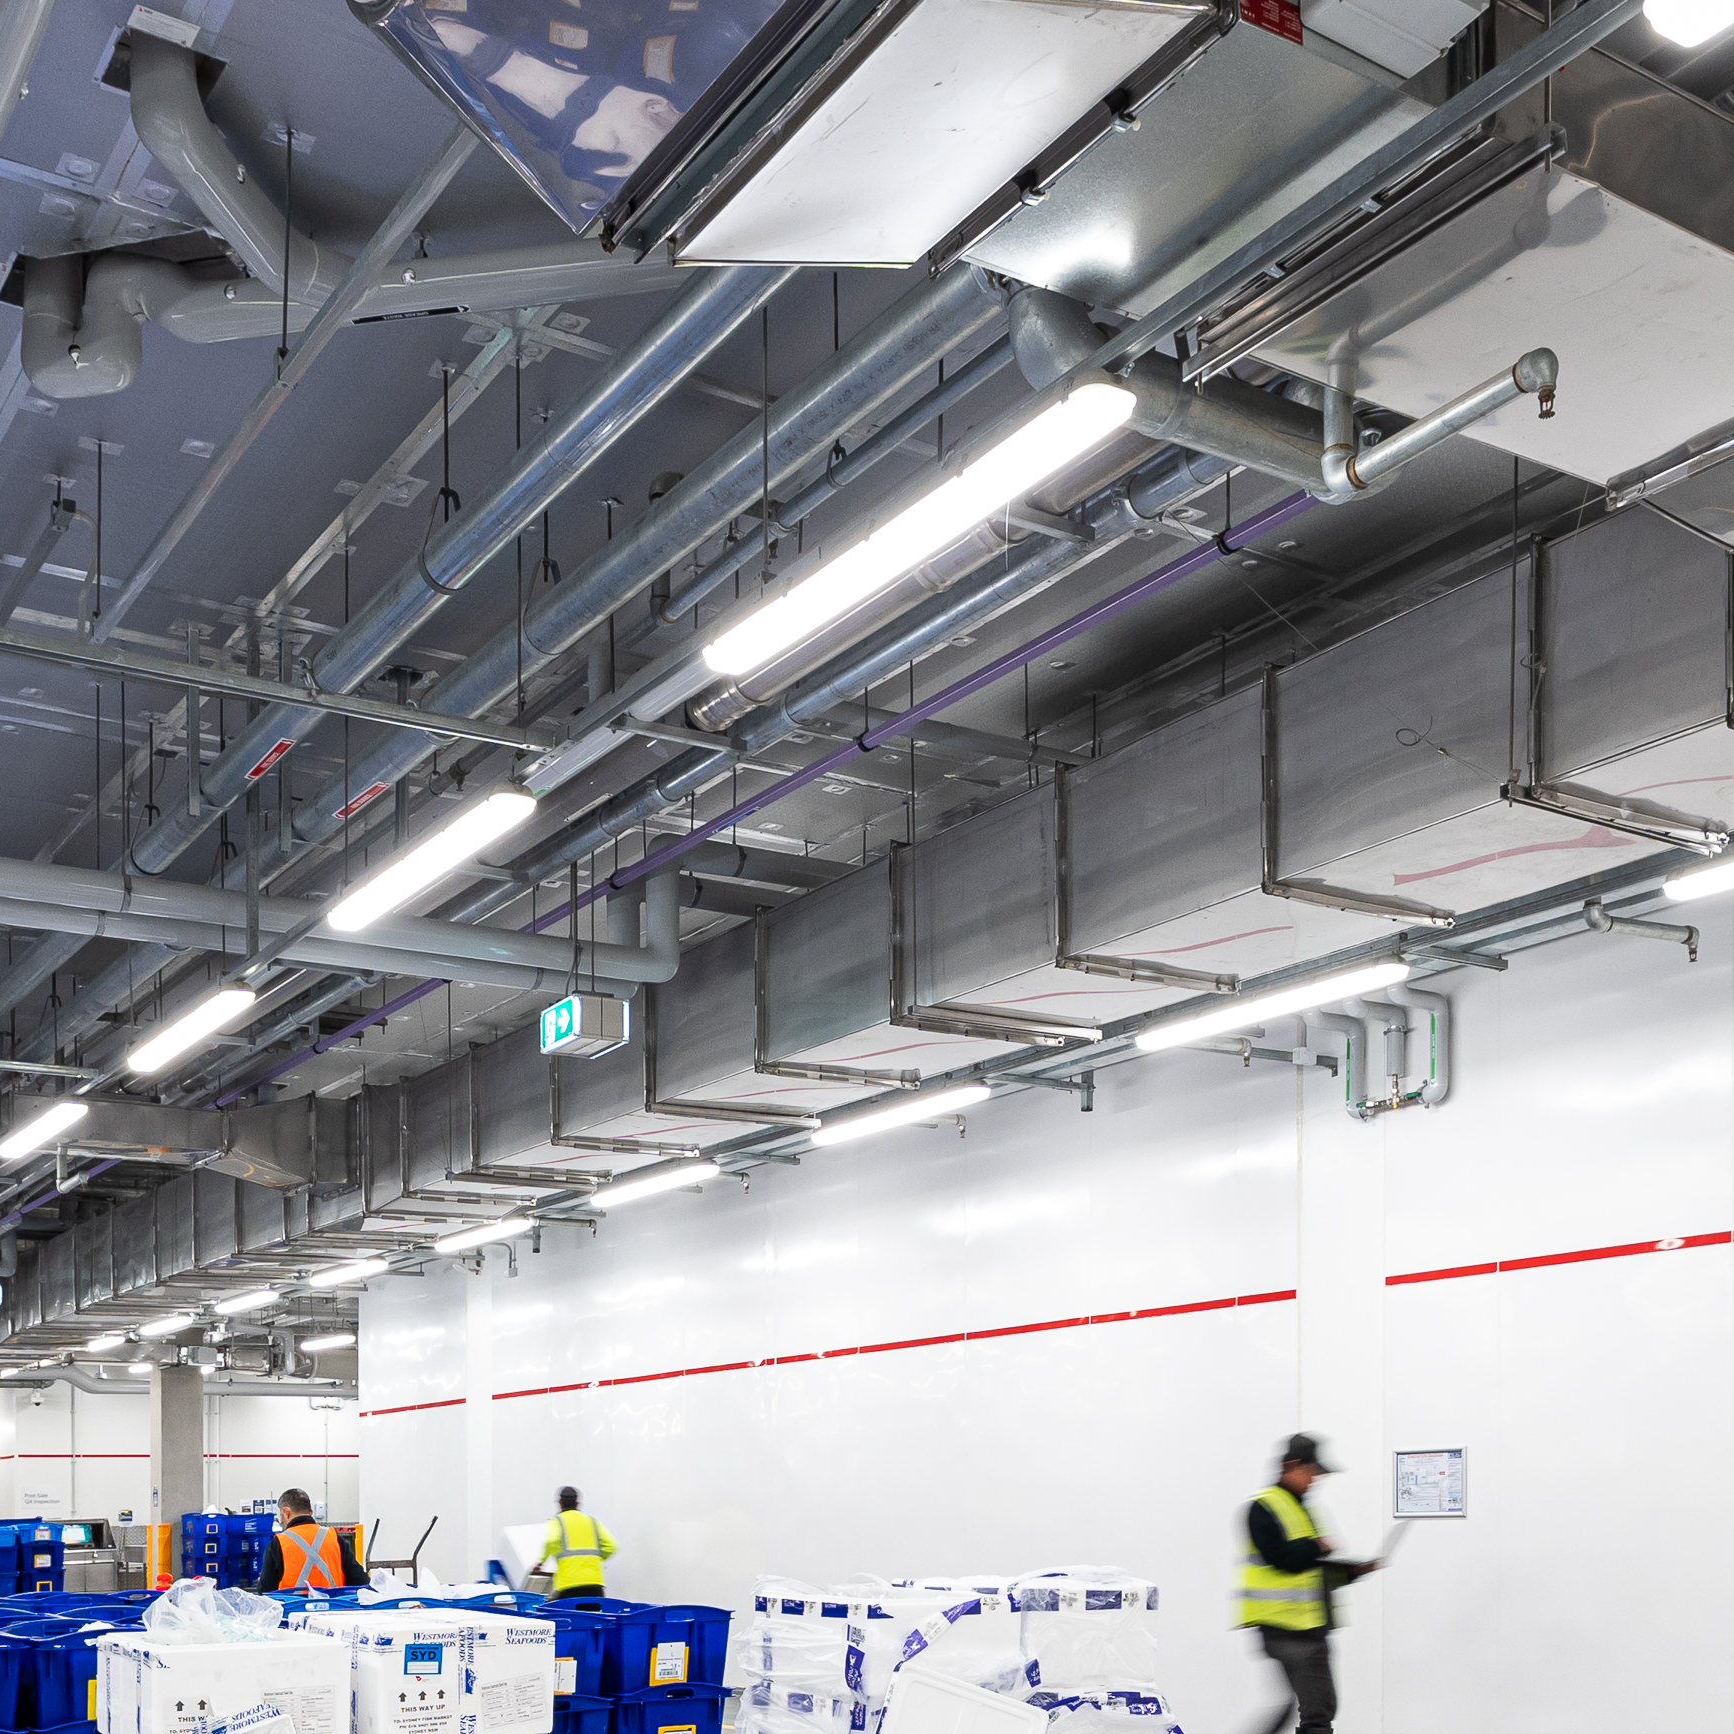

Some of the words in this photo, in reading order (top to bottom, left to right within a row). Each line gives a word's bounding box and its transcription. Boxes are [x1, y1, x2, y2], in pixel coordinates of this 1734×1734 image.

[506, 1628, 552, 1638] WESTMORE
[505, 1636, 547, 1645] SEAFOODS
[410, 1650, 436, 1661] SYD
